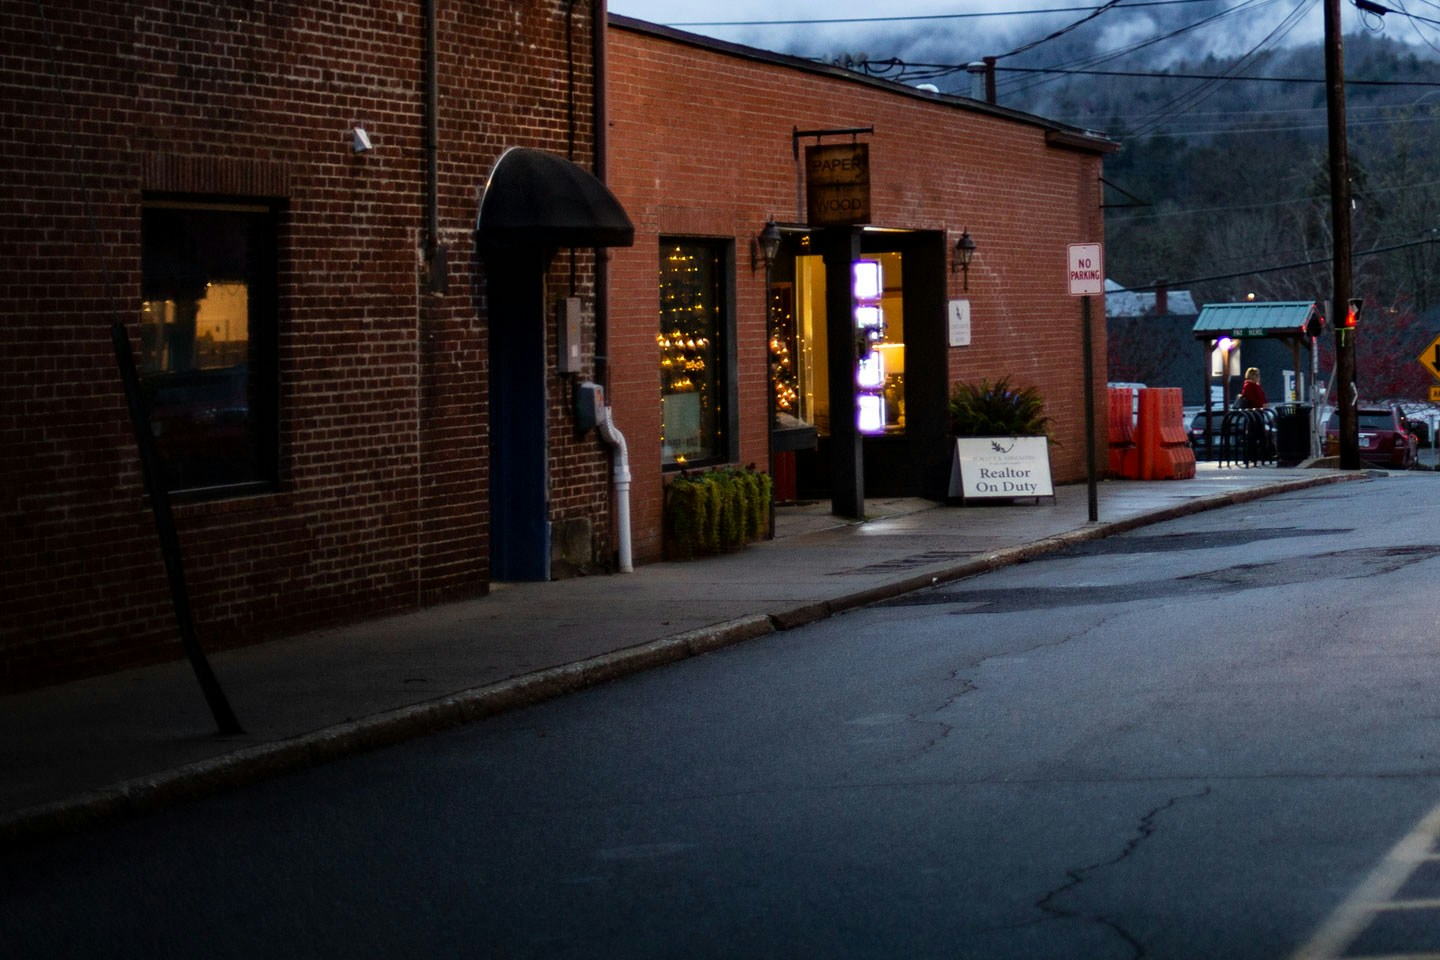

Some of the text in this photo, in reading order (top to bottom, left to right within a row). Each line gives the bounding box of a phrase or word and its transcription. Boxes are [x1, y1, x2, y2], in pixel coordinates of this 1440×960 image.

[811, 158, 862, 172] PAPER
[817, 198, 862, 212] WOOD
[1078, 258, 1092, 269] NO
[1070, 270, 1100, 281] PARKING
[980, 467, 1031, 479] Realtor
[976, 481, 1038, 495] On Duty
